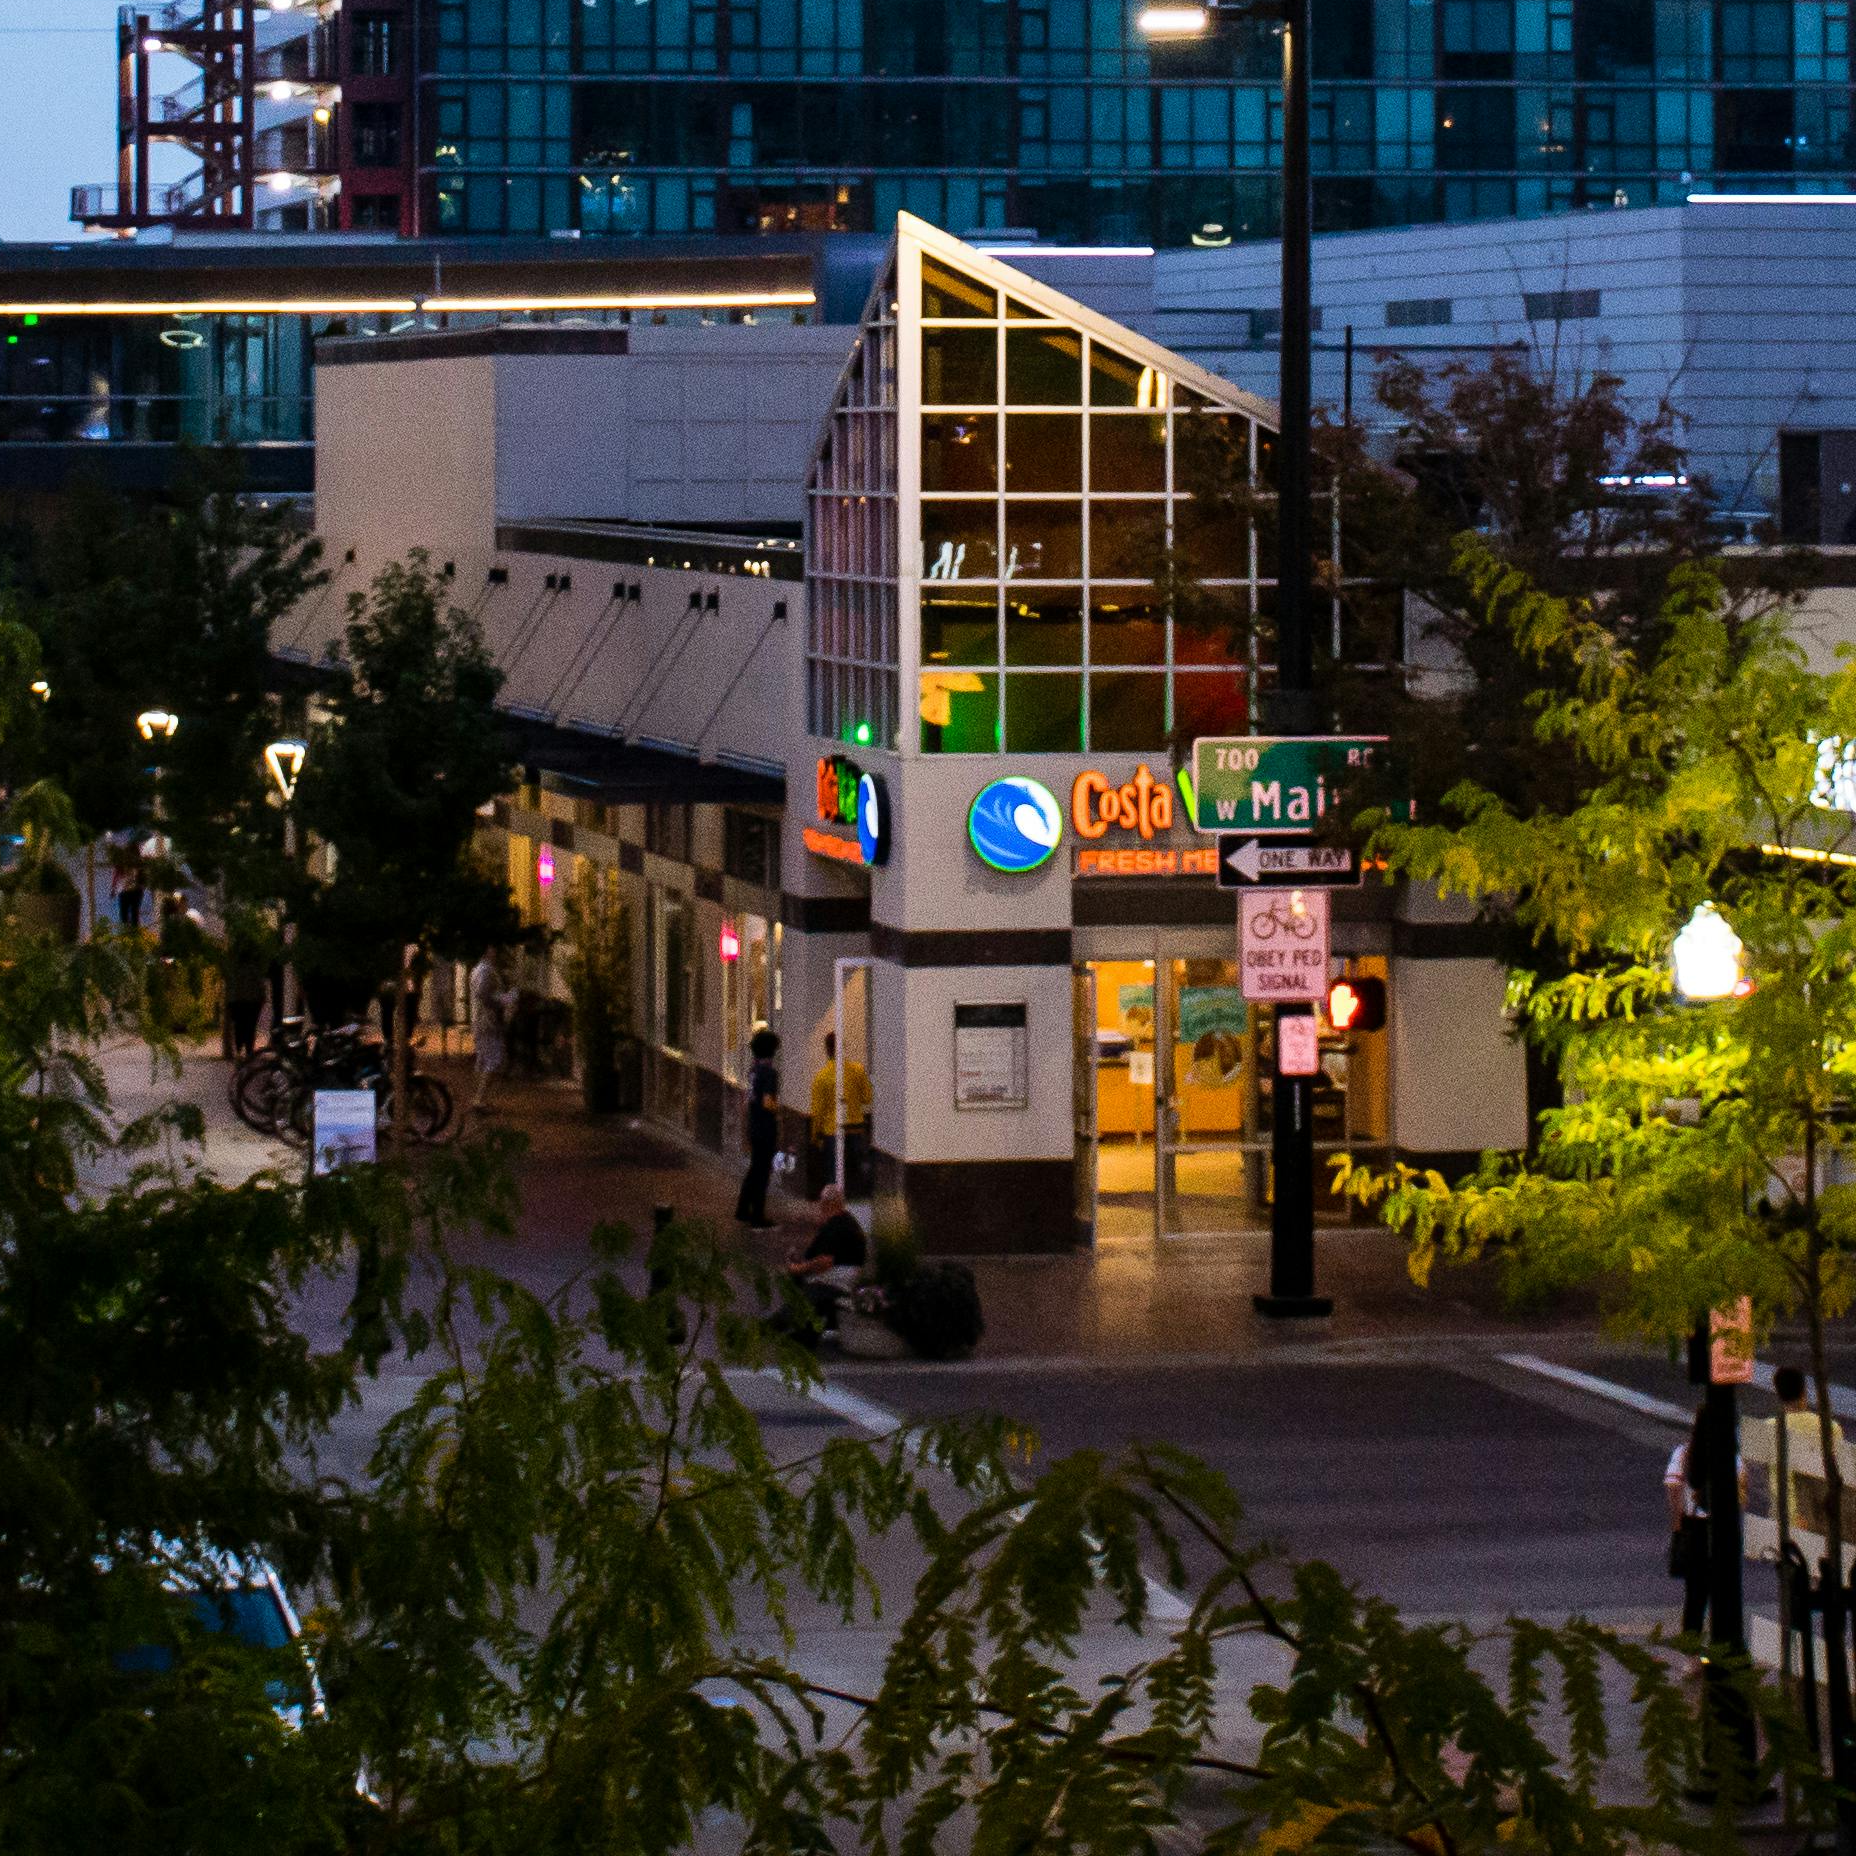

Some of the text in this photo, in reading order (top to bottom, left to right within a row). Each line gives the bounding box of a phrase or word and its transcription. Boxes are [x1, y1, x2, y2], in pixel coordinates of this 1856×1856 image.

[1215, 748, 1260, 771] 700
[1072, 763, 1173, 840] Costa
[1215, 799, 1238, 821] W
[1251, 774, 1343, 821] Mai
[1078, 849, 1177, 875] FRESH
[1259, 850, 1296, 869] ONE
[1308, 847, 1346, 867] WAY
[1294, 949, 1323, 966] PED
[1257, 973, 1310, 991] SIGNAL
